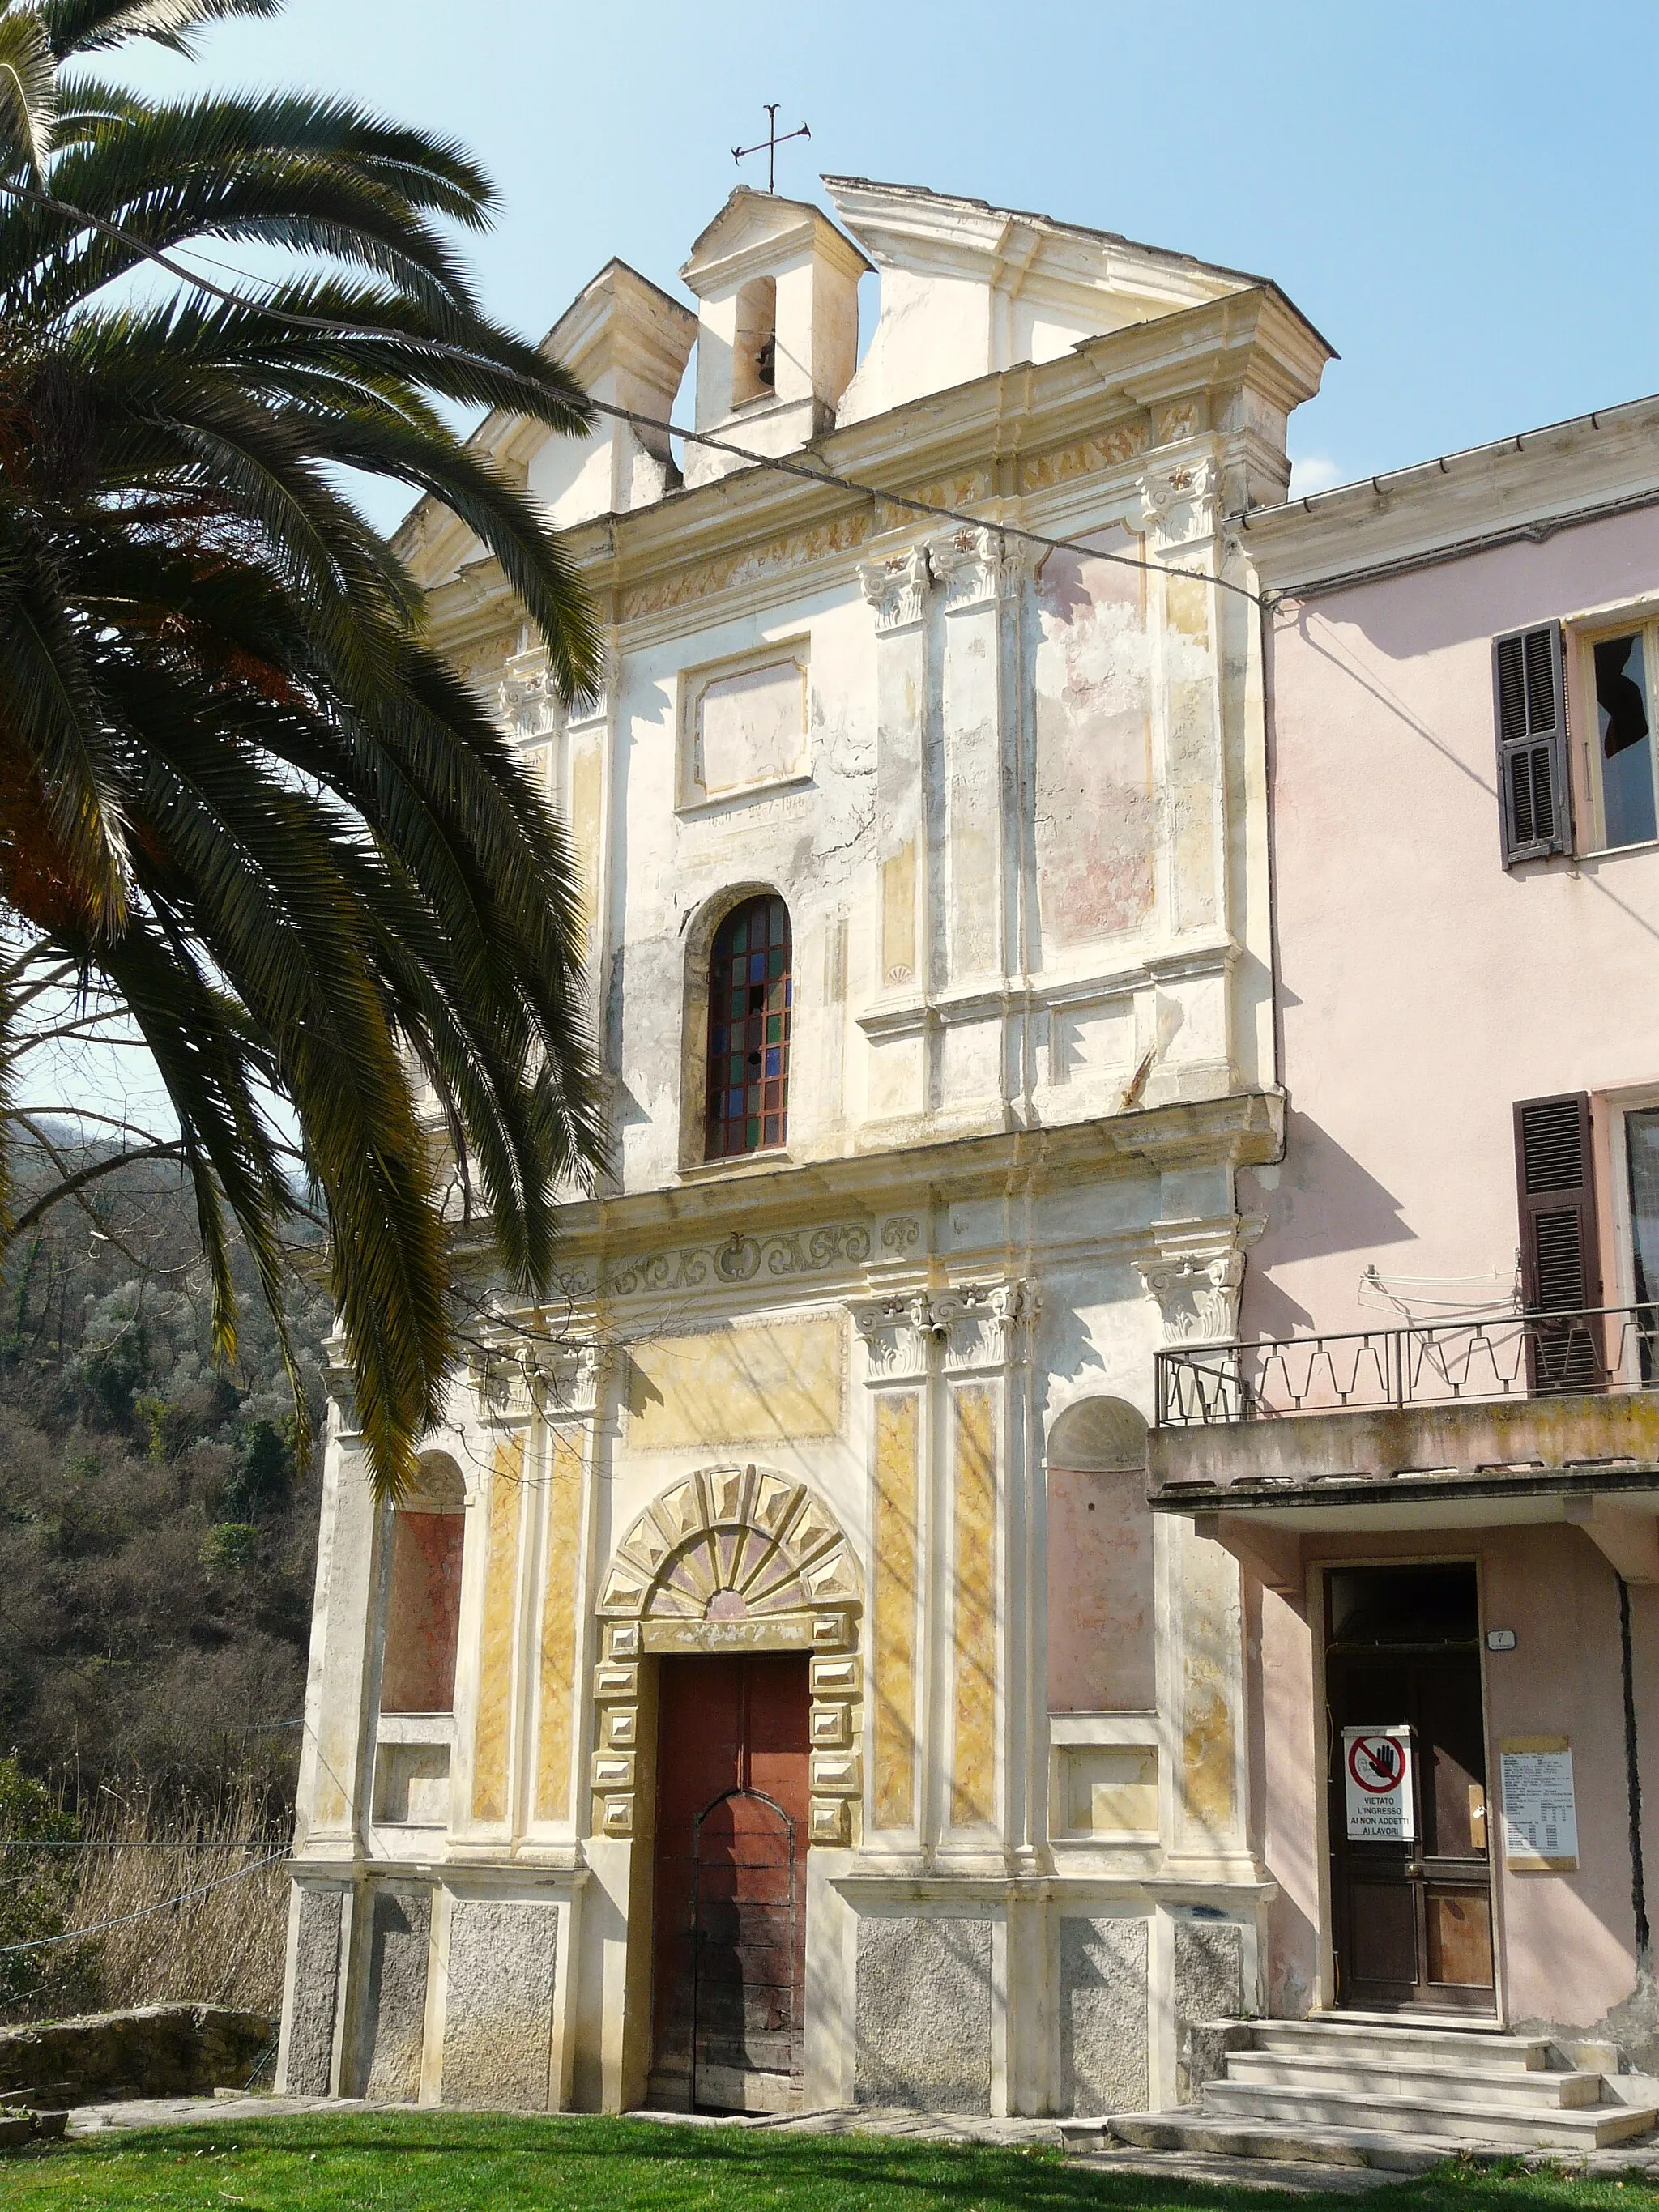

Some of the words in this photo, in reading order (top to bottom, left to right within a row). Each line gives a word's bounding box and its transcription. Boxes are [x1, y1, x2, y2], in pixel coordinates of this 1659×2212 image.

[1497, 1633, 1503, 1643] 7
[1360, 1817, 1376, 1825] NON
[1363, 1827, 1371, 1835] AI
[1372, 1827, 1399, 1835] LAVORI
